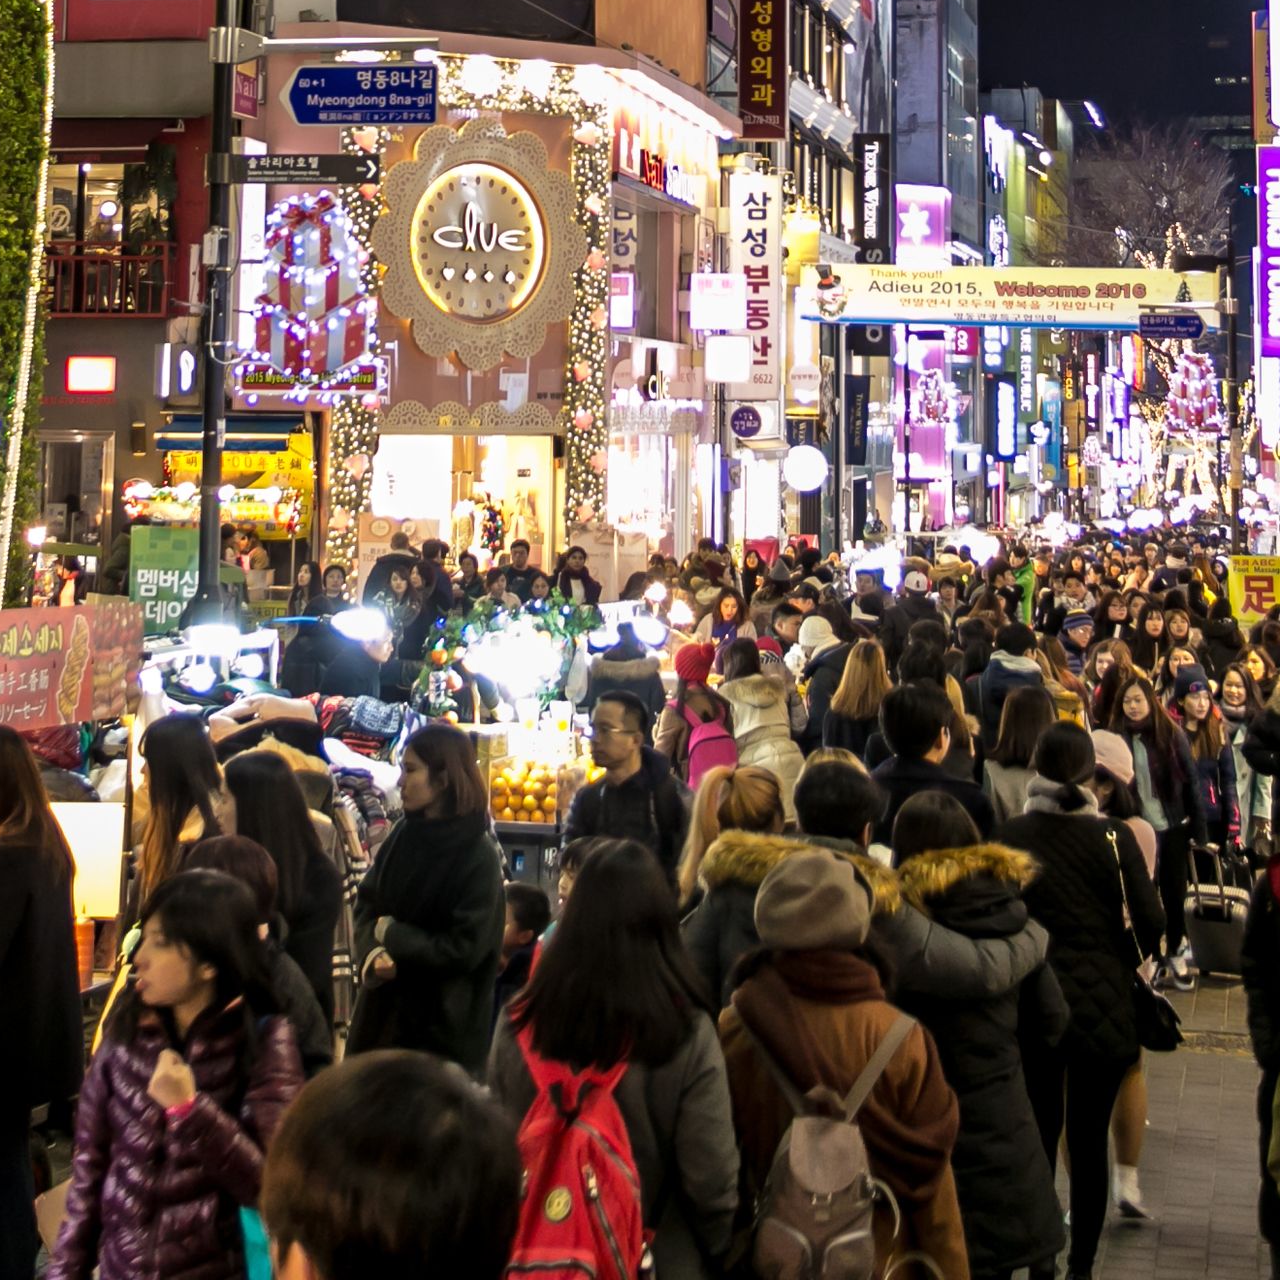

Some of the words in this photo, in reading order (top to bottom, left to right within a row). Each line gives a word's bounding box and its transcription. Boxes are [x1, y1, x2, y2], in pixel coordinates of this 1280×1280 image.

[750, 1, 775, 107] 성형외과
[357, 70, 434, 89] 명동8나길
[307, 93, 387, 108] Myeongdong
[389, 93, 433, 107] 8na-gil
[742, 192, 772, 257] 삼성
[870, 269, 908, 278] Thank
[912, 270, 943, 280] you!!
[868, 280, 923, 293] Adieu
[931, 281, 982, 296] 2015,
[994, 281, 1091, 298] Welcome
[1095, 282, 1147, 299] 2016
[900, 298, 951, 308] 연말연시
[958, 299, 996, 308] 모두의
[1002, 300, 1040, 310] 행복을
[1048, 301, 1115, 311] 기원합니다
[245, 372, 264, 383] 2015
[753, 373, 773, 384] 6622
[1241, 575, 1276, 614] 足
